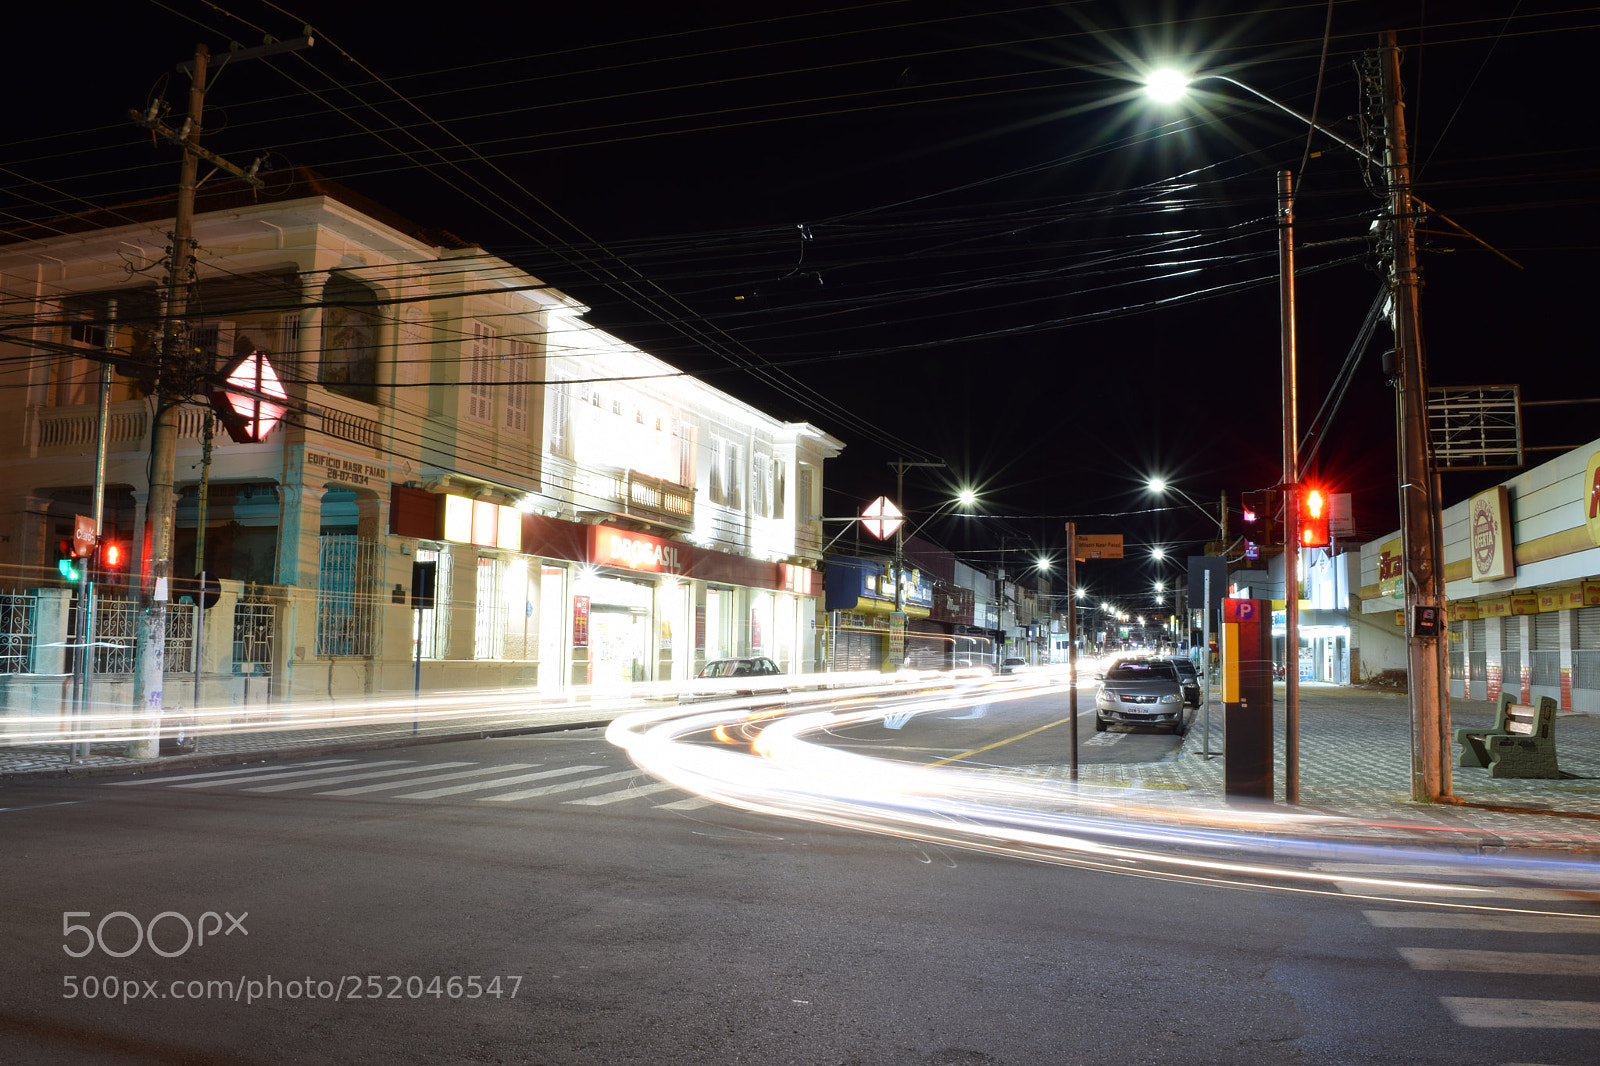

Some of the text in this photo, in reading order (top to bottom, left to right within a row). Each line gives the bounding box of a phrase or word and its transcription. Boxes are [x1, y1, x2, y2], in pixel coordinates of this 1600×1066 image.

[342, 460, 363, 474] NASR
[327, 468, 369, 485] 28-07-1934
[610, 535, 681, 568] DROGASIL
[1240, 603, 1251, 618] P
